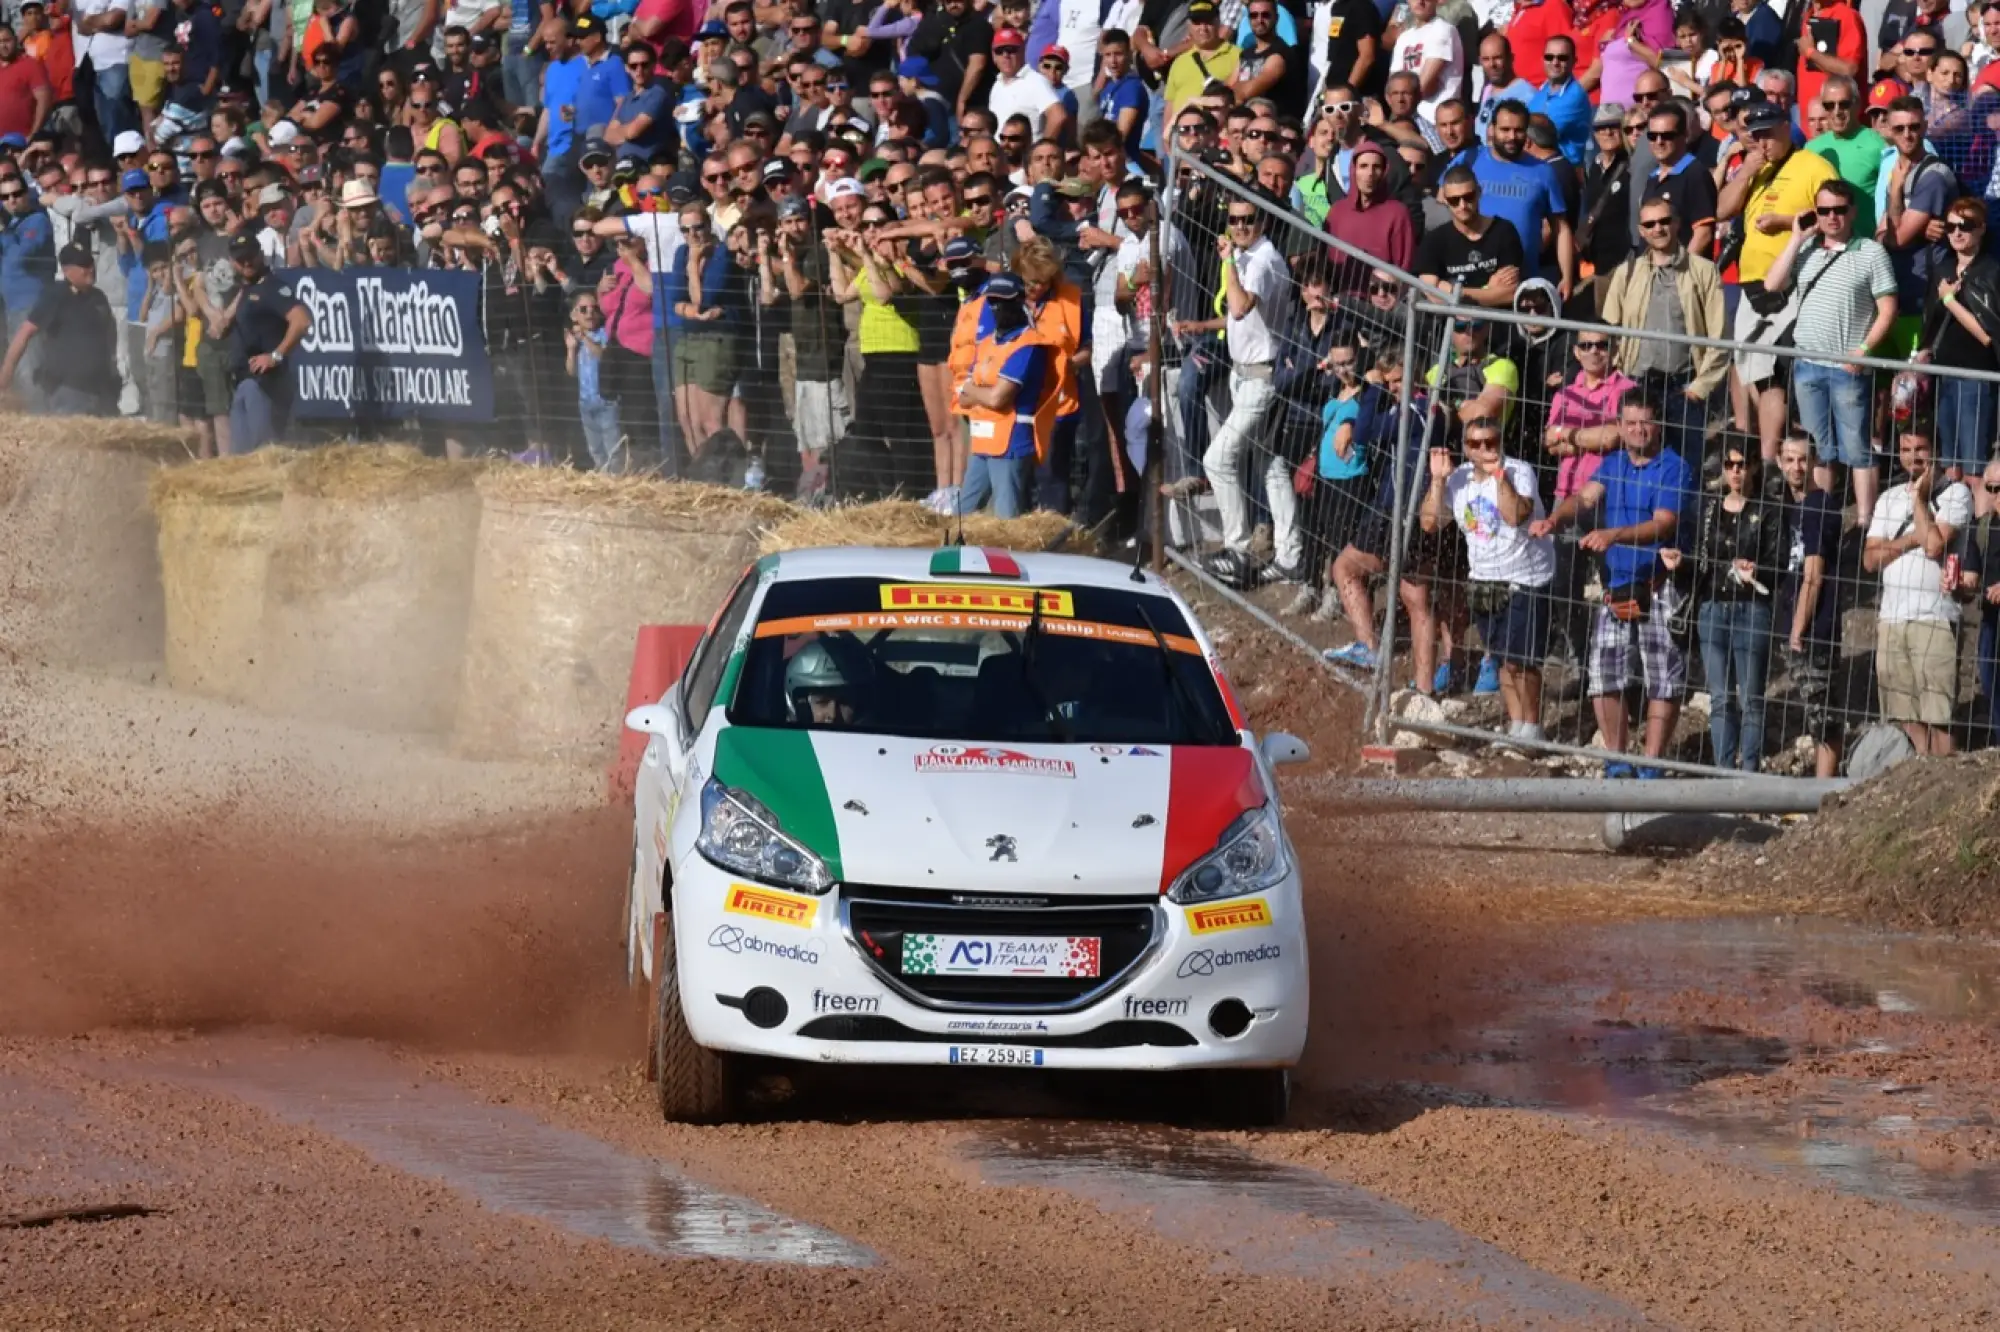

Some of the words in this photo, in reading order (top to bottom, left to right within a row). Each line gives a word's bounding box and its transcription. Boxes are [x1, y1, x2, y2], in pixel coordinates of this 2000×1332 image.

[297, 276, 353, 352] San
[357, 278, 463, 356] Martino
[373, 366, 472, 405] SPETTACOLARE
[868, 615, 898, 625] FIA
[903, 614, 944, 625] WRC
[950, 615, 961, 625] 3
[921, 755, 957, 767] RALLY
[961, 755, 1000, 768] ITALIA
[1003, 758, 1070, 773] SARDEGNA
[732, 889, 808, 921] PIRELLI
[1193, 903, 1264, 929] PIRELLI
[949, 940, 992, 965] ACI
[998, 942, 1045, 953] TEAM
[992, 955, 1048, 966] ITALIA
[813, 989, 879, 1012] freem
[1125, 995, 1187, 1017] freem
[960, 1048, 979, 1063] EZ
[987, 1049, 1032, 1064] 259JE
